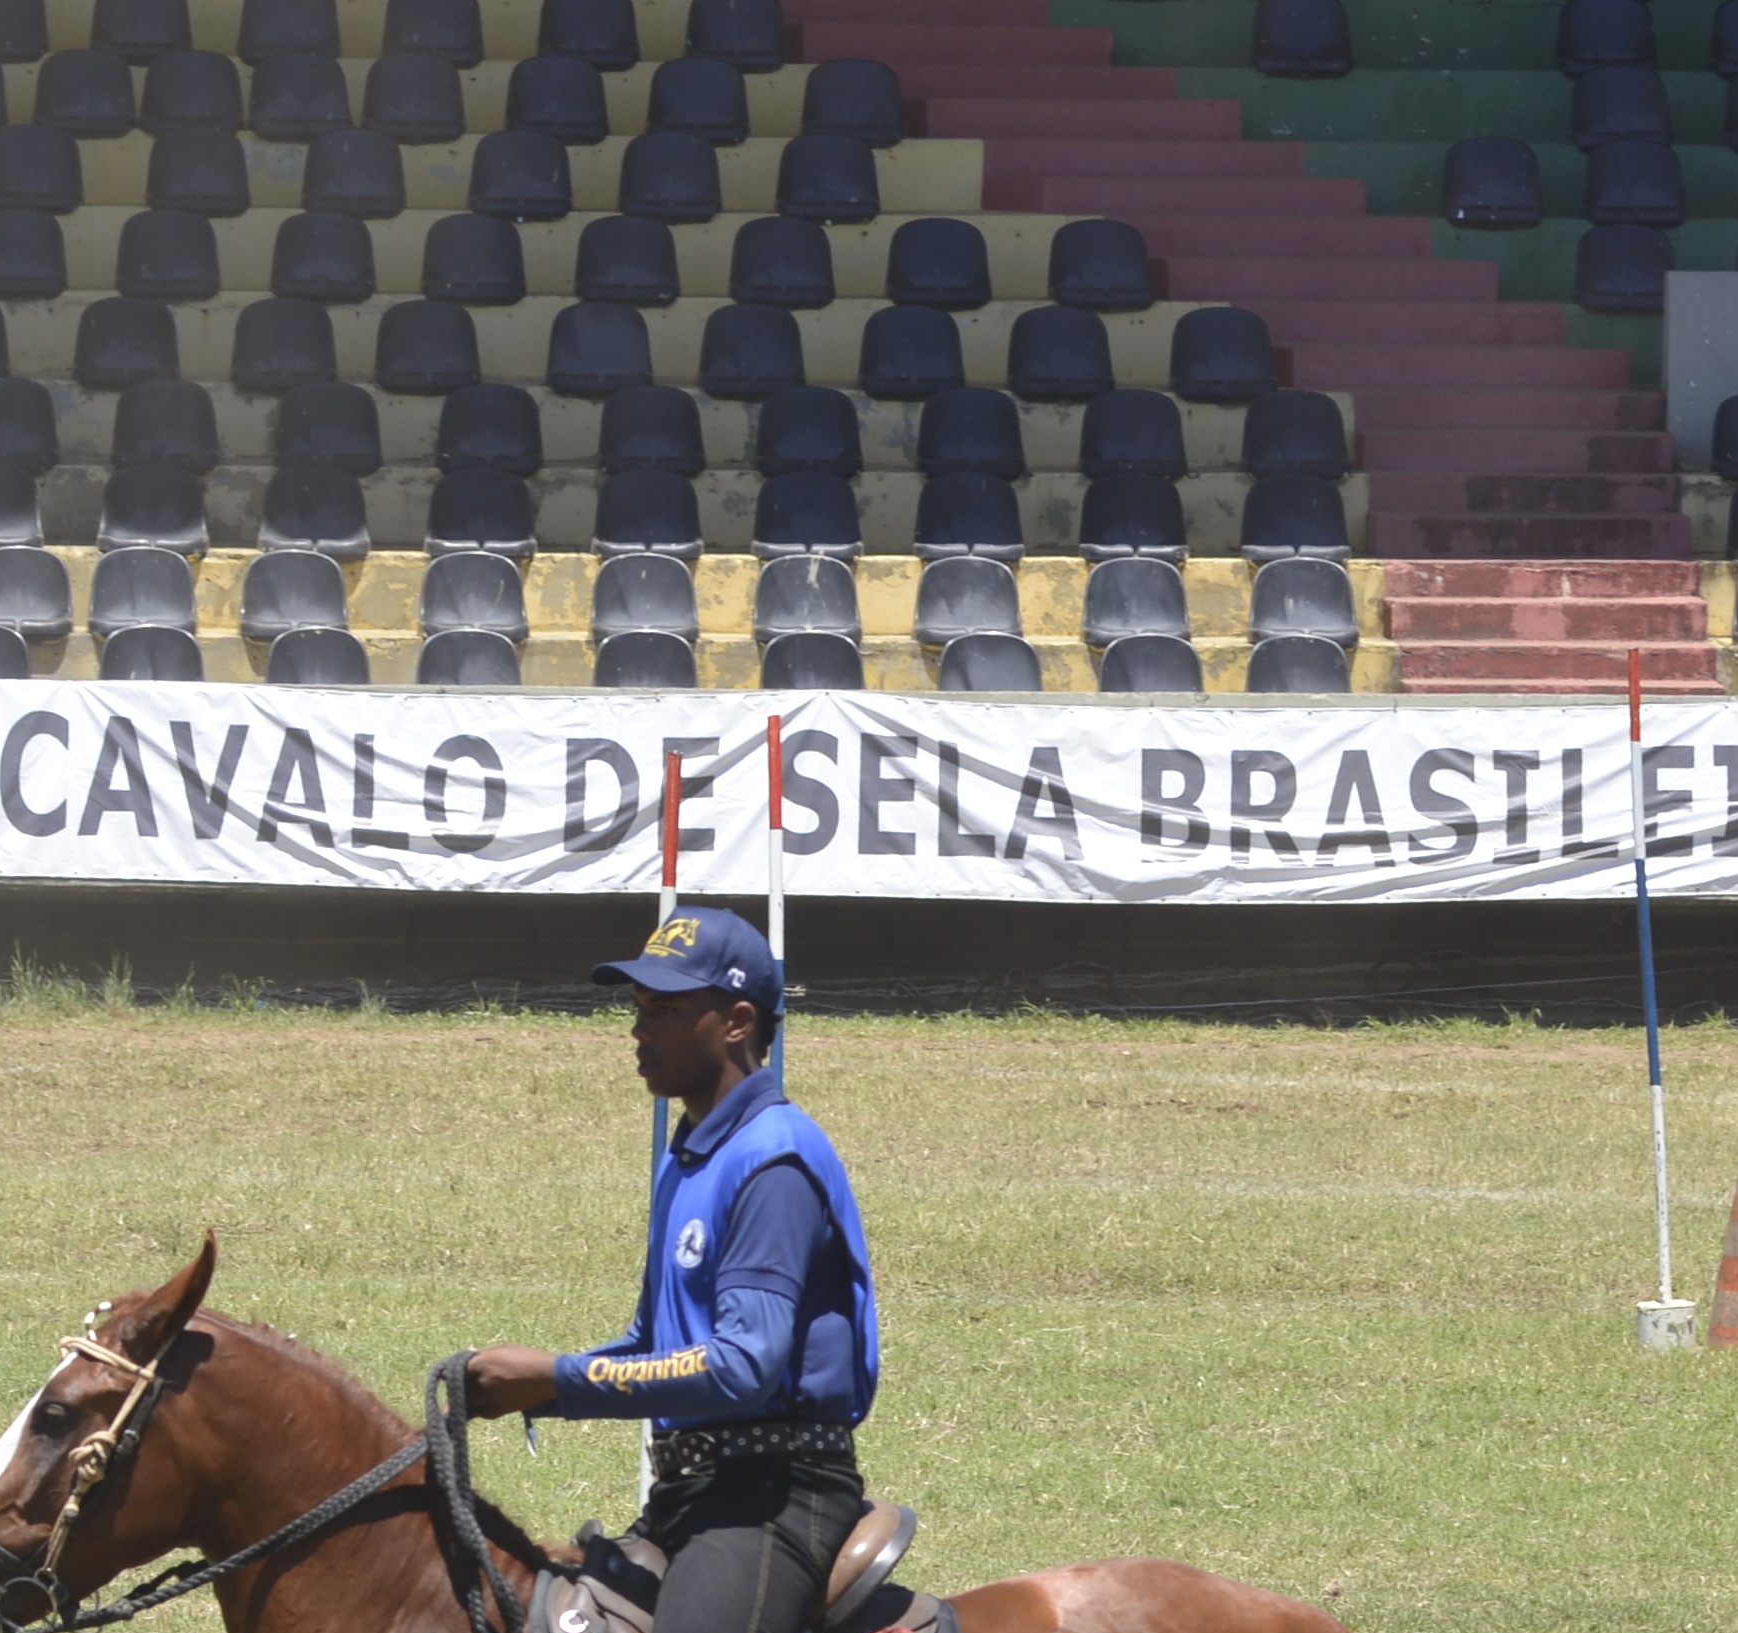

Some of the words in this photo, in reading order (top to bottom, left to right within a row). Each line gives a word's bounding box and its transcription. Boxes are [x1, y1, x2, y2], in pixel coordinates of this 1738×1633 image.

[0, 710, 507, 853] CAVALO
[563, 735, 720, 852] DE
[779, 729, 1085, 861] SELA
